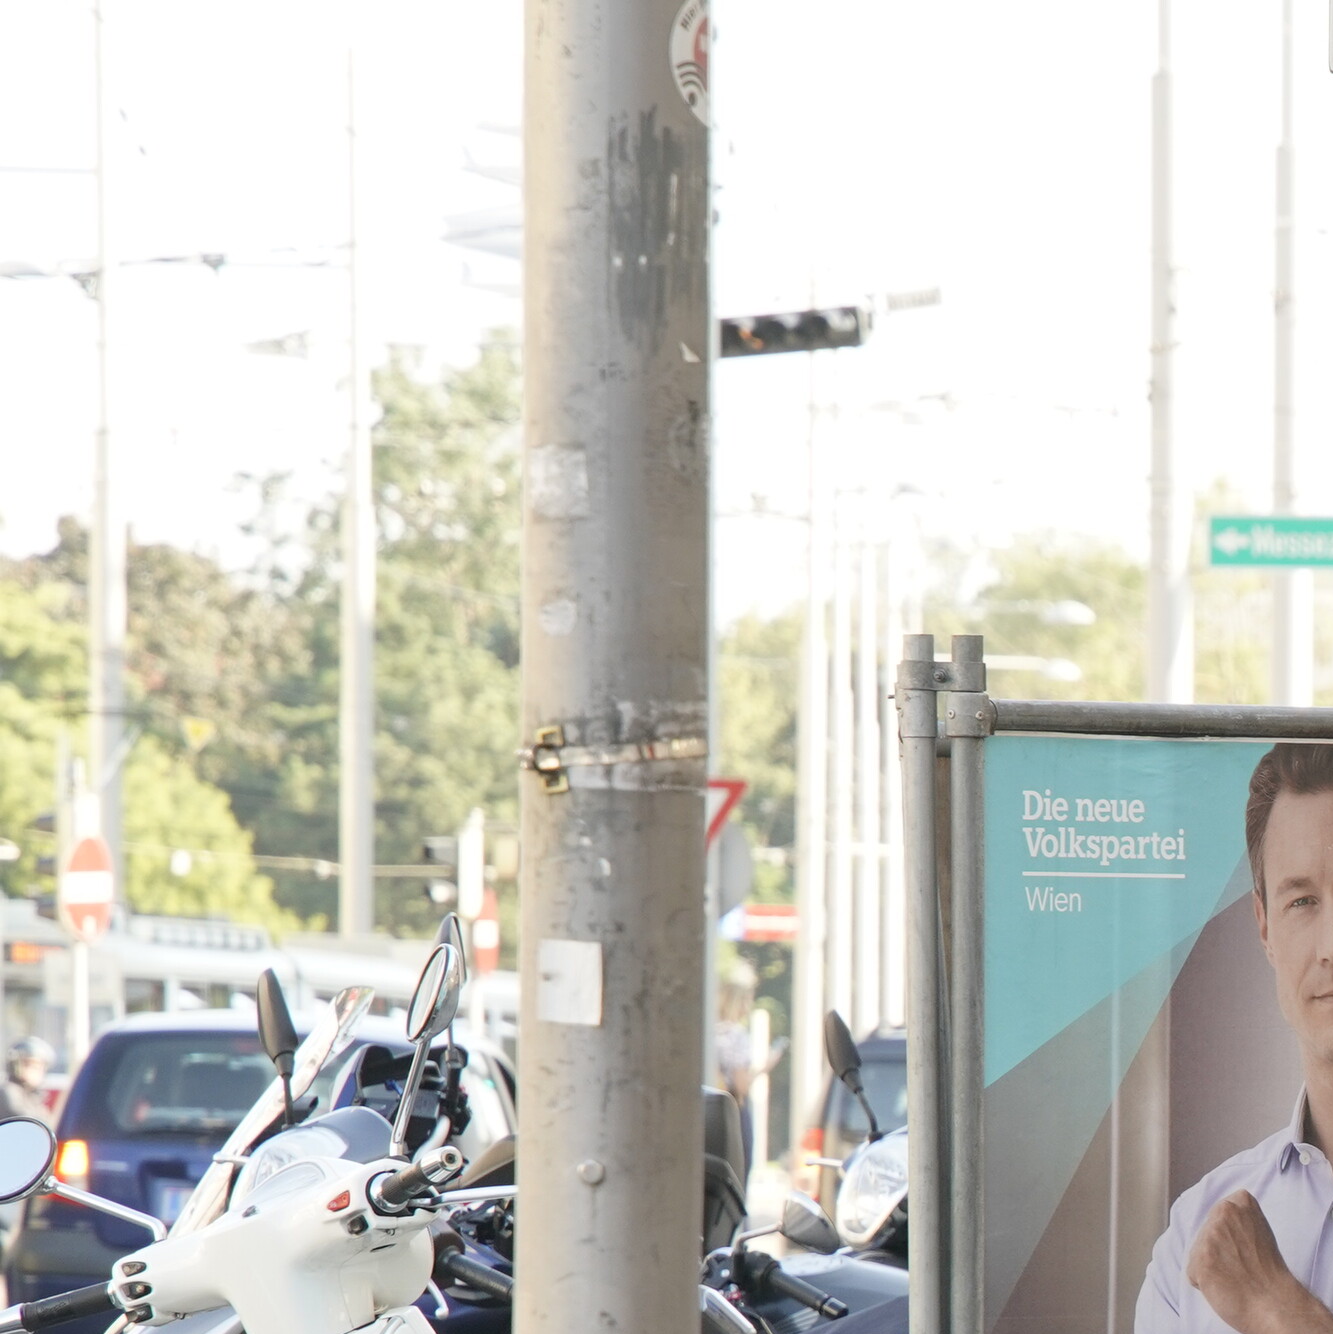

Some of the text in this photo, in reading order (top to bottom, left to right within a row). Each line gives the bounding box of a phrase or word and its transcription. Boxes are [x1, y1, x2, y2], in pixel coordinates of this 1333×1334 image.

[1022, 789, 1145, 823] Die neue
[1022, 826, 1186, 866] Volkspartei
[1025, 886, 1081, 912] Wien
